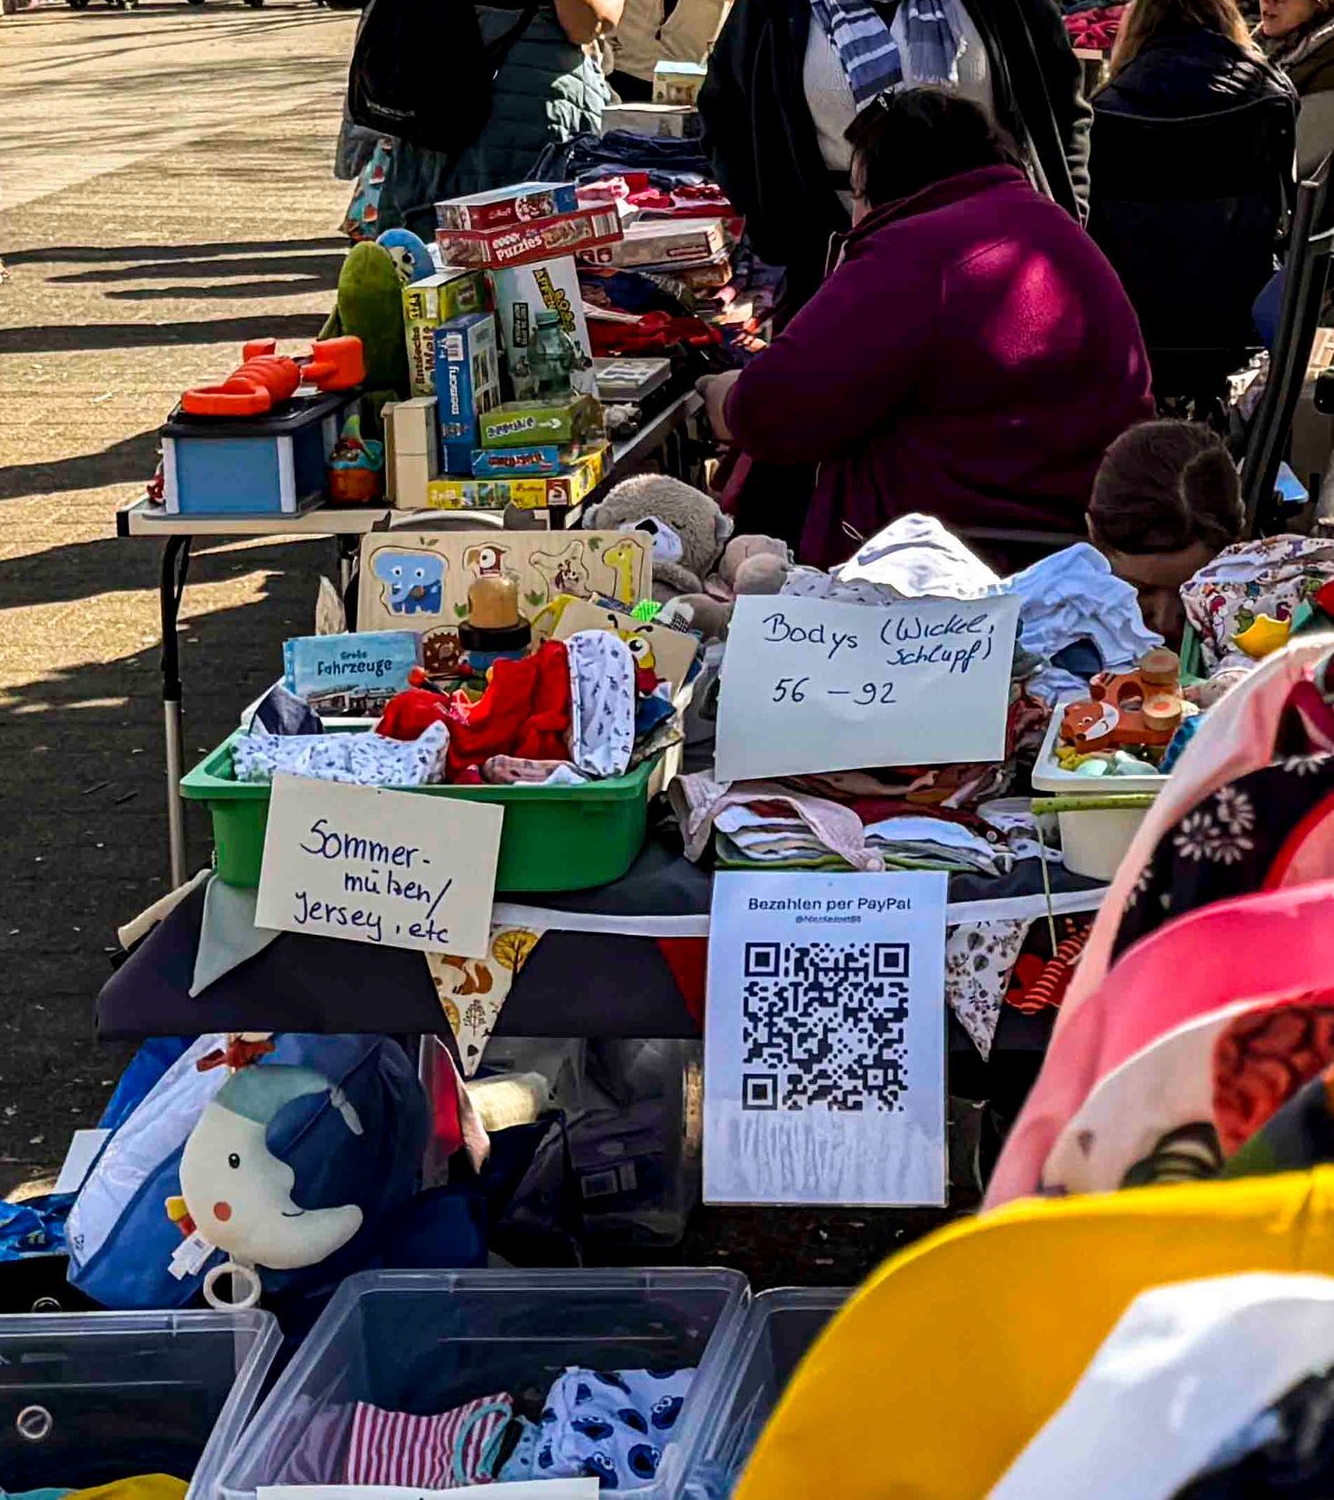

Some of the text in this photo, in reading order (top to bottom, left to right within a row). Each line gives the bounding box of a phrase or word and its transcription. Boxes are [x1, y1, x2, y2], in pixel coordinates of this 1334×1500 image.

[451, 365, 460, 415] memory
[762, 613, 858, 659] Bodys
[317, 659, 393, 678] Fahrzeuge
[772, 677, 810, 703] 56
[748, 898, 912, 913] Bezahlen per PayPal
